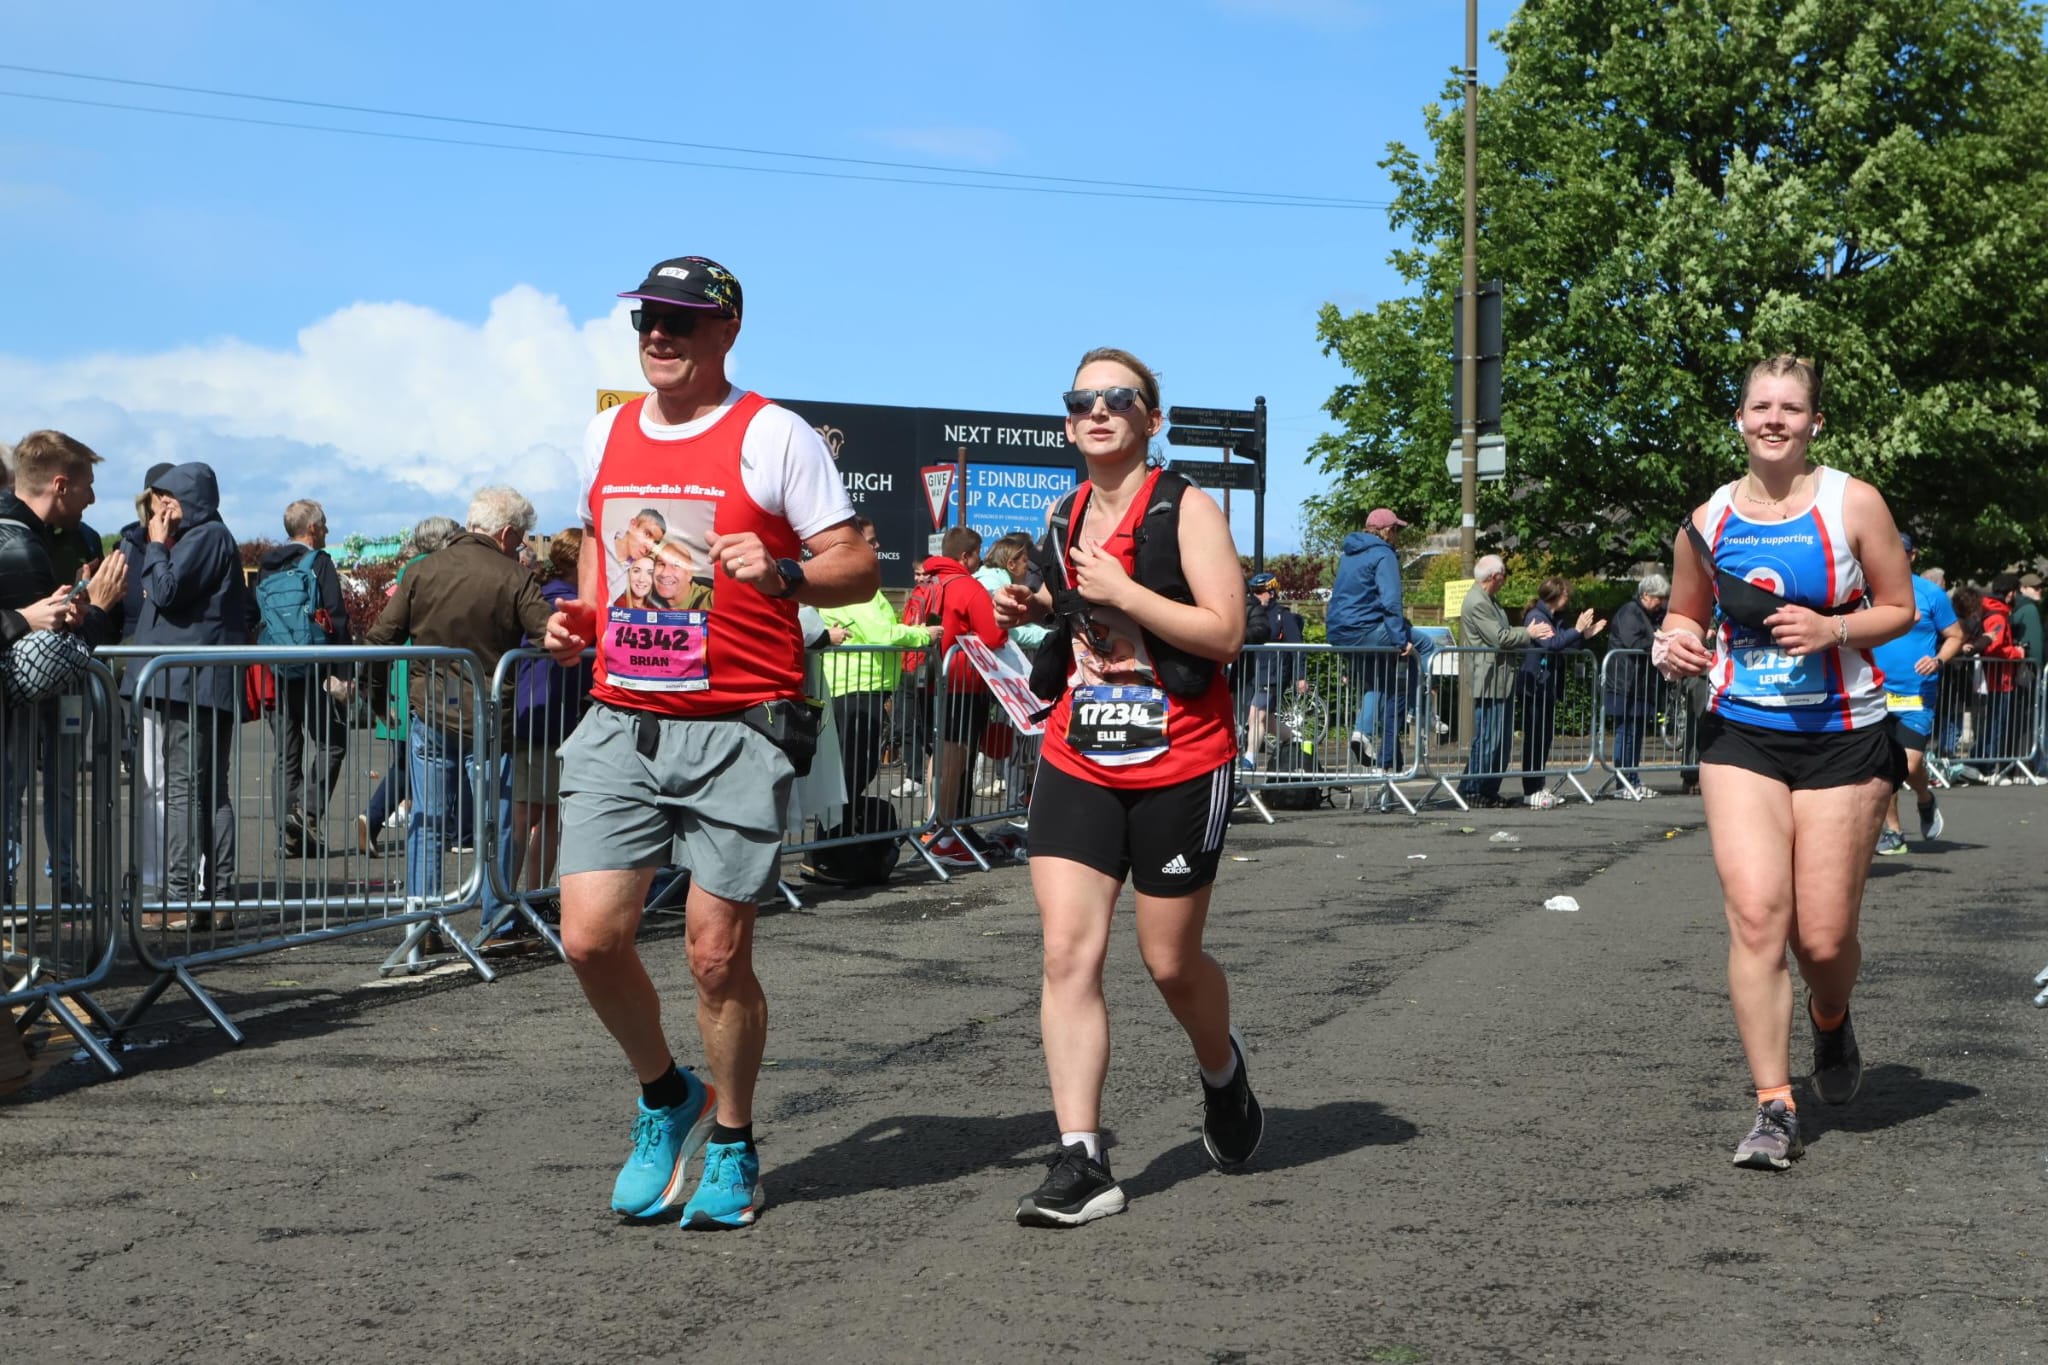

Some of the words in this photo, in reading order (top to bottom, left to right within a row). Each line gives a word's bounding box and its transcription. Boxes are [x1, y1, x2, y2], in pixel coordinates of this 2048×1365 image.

[944, 424, 992, 445] NEXT
[997, 427, 1065, 448] FIXTURE
[840, 471, 893, 492] URGH
[928, 473, 947, 487] GIVE
[979, 471, 1071, 491] EDINBURGH
[931, 487, 944, 498] WAY
[949, 490, 982, 508] CUP
[987, 492, 1061, 510] RACEDAY
[1723, 535, 1760, 546] Proudly
[1761, 534, 1814, 546] supporting
[615, 625, 690, 651] 14342
[629, 655, 669, 667] BRIAN
[1079, 703, 1150, 726] 17234
[1096, 731, 1127, 742] ELLIE
